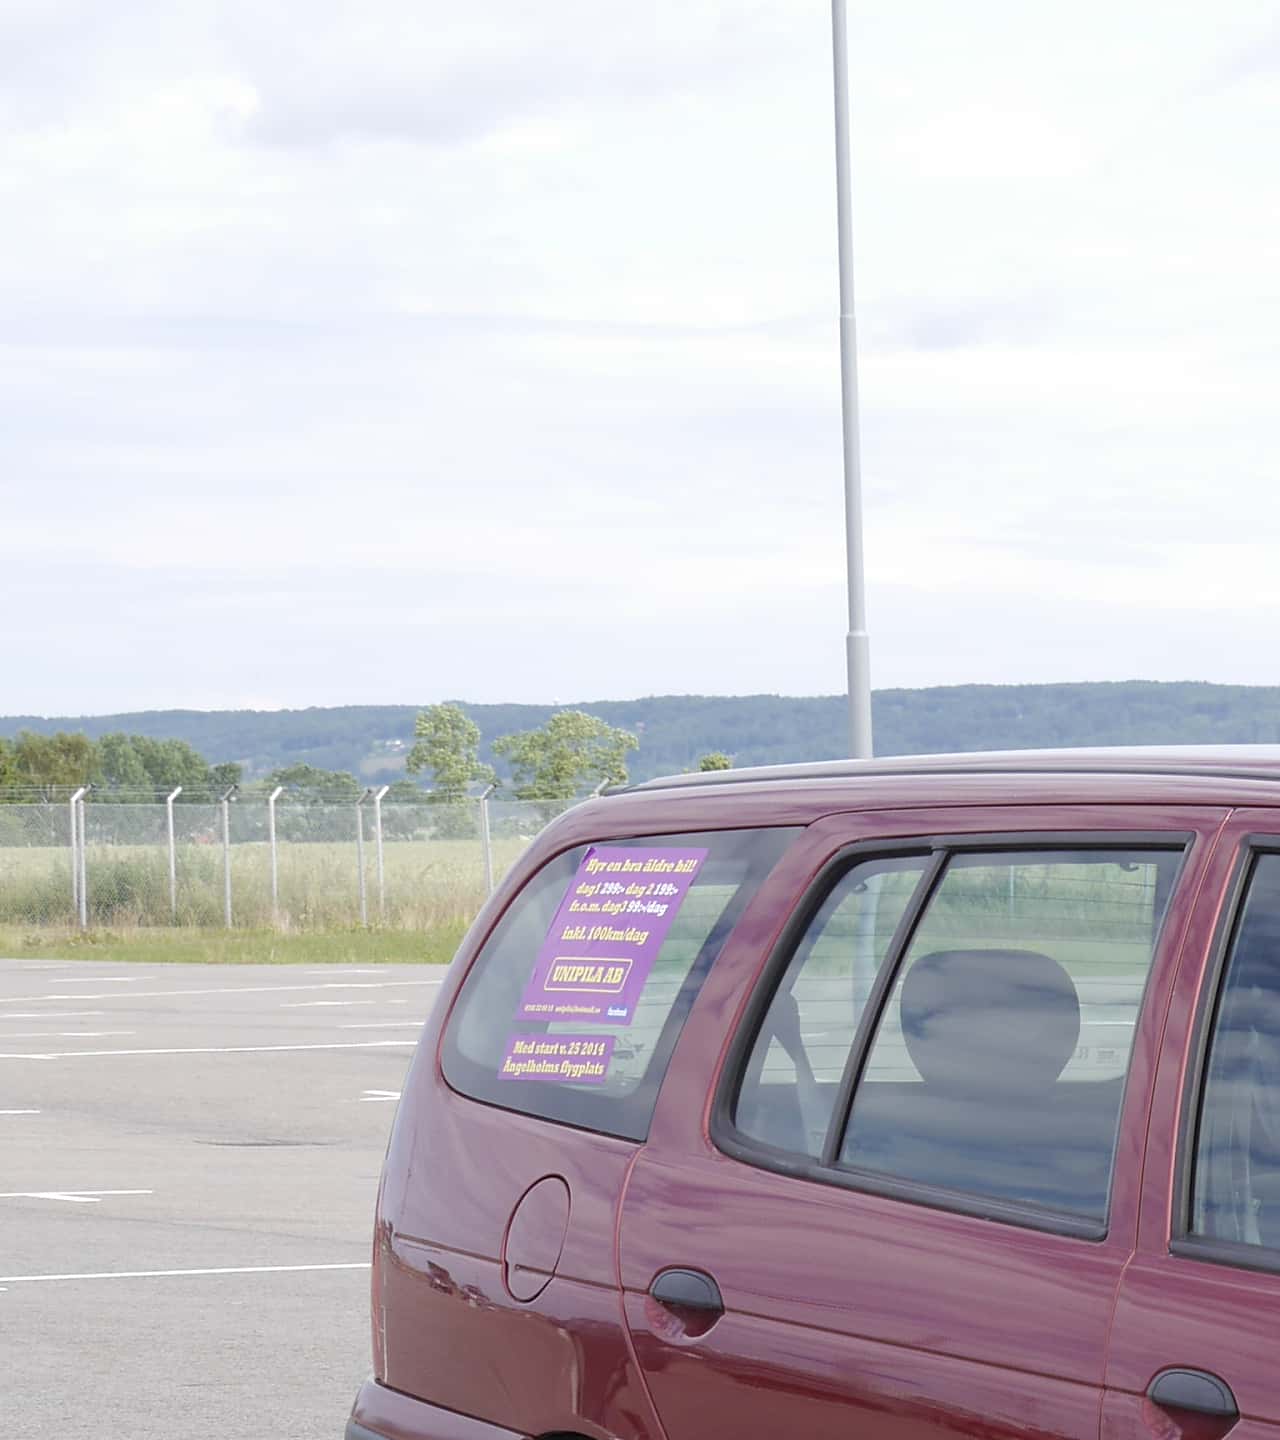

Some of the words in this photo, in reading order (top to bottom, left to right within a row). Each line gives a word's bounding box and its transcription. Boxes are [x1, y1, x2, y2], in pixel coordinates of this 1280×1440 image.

[585, 858, 607, 875] Hyr
[606, 861, 621, 872] en
[621, 859, 642, 872] bra
[642, 859, 675, 872] äldre
[673, 859, 698, 873] bil!
[625, 882, 647, 898] dag
[645, 883, 655, 895] 2
[561, 926, 586, 940] inkl.
[552, 965, 604, 983] UNIPILA
[602, 967, 624, 984] AB
[513, 1040, 535, 1054] Med
[534, 1042, 560, 1055] start
[567, 1042, 581, 1055] 25
[580, 1042, 605, 1056] 2014
[502, 1056, 560, 1076] Ängelholms
[559, 1060, 604, 1078] flygplats
